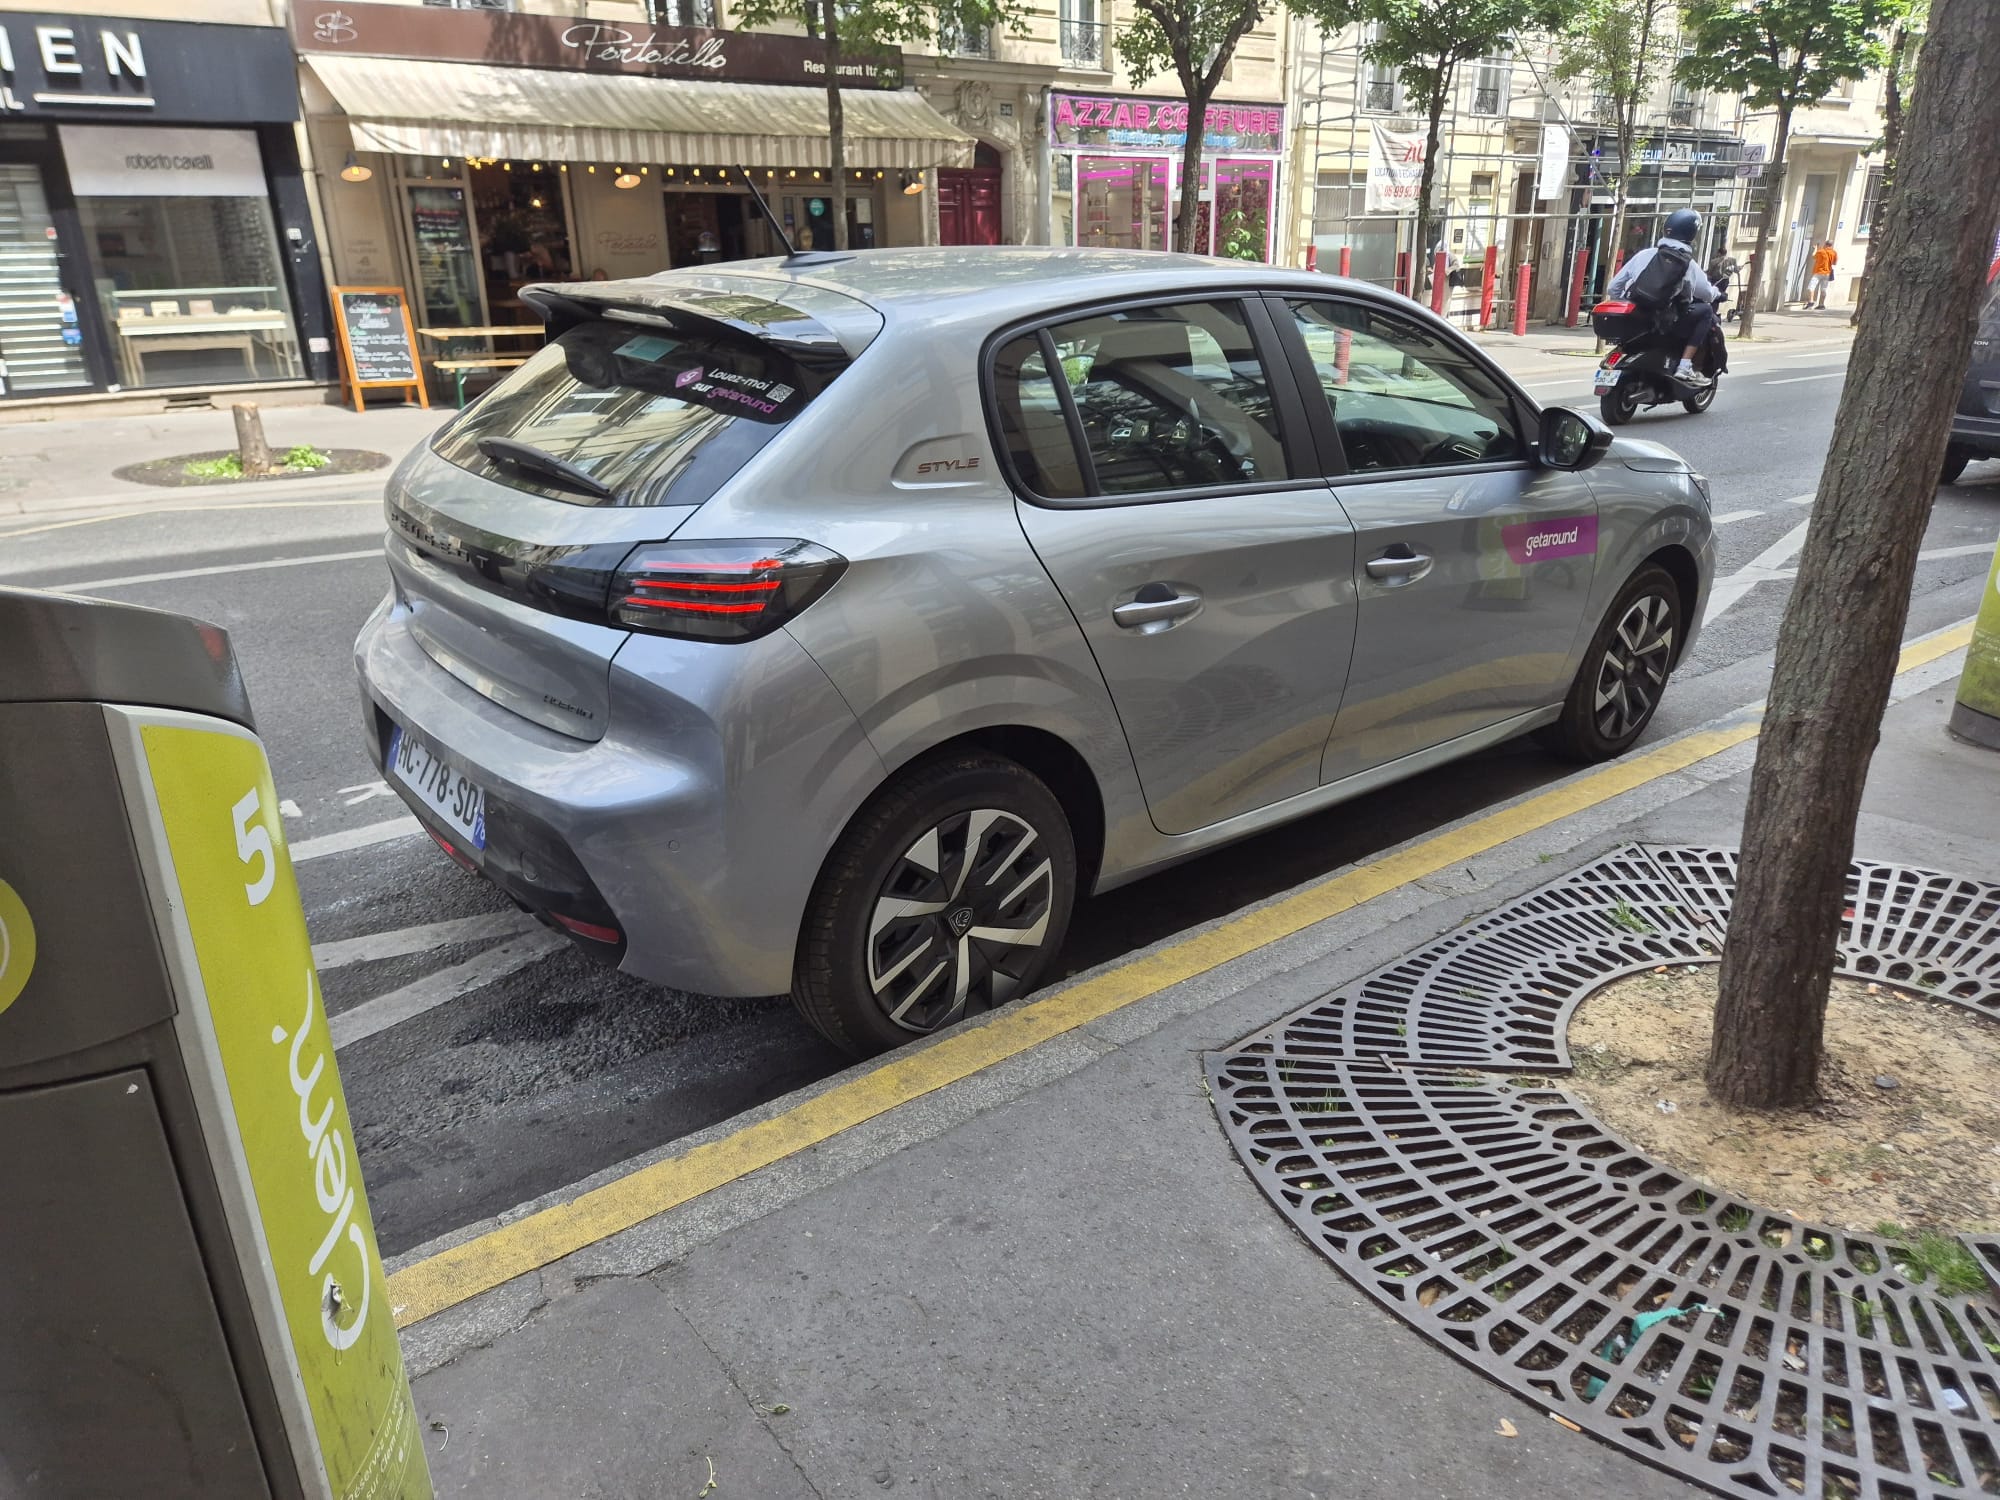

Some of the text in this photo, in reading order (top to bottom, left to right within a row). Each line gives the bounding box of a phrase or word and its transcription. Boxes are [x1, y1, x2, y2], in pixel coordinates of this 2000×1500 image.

[561, 24, 727, 69] Portobello
[803, 60, 863, 76] Resurant
[1056, 99, 1281, 135] AZZAR COFFURE
[708, 367, 773, 391] Louez-moi
[692, 381, 778, 414] sur getaround
[917, 457, 980, 474] STYLE
[1526, 526, 1578, 557] getaround
[232, 787, 275, 906] 5
